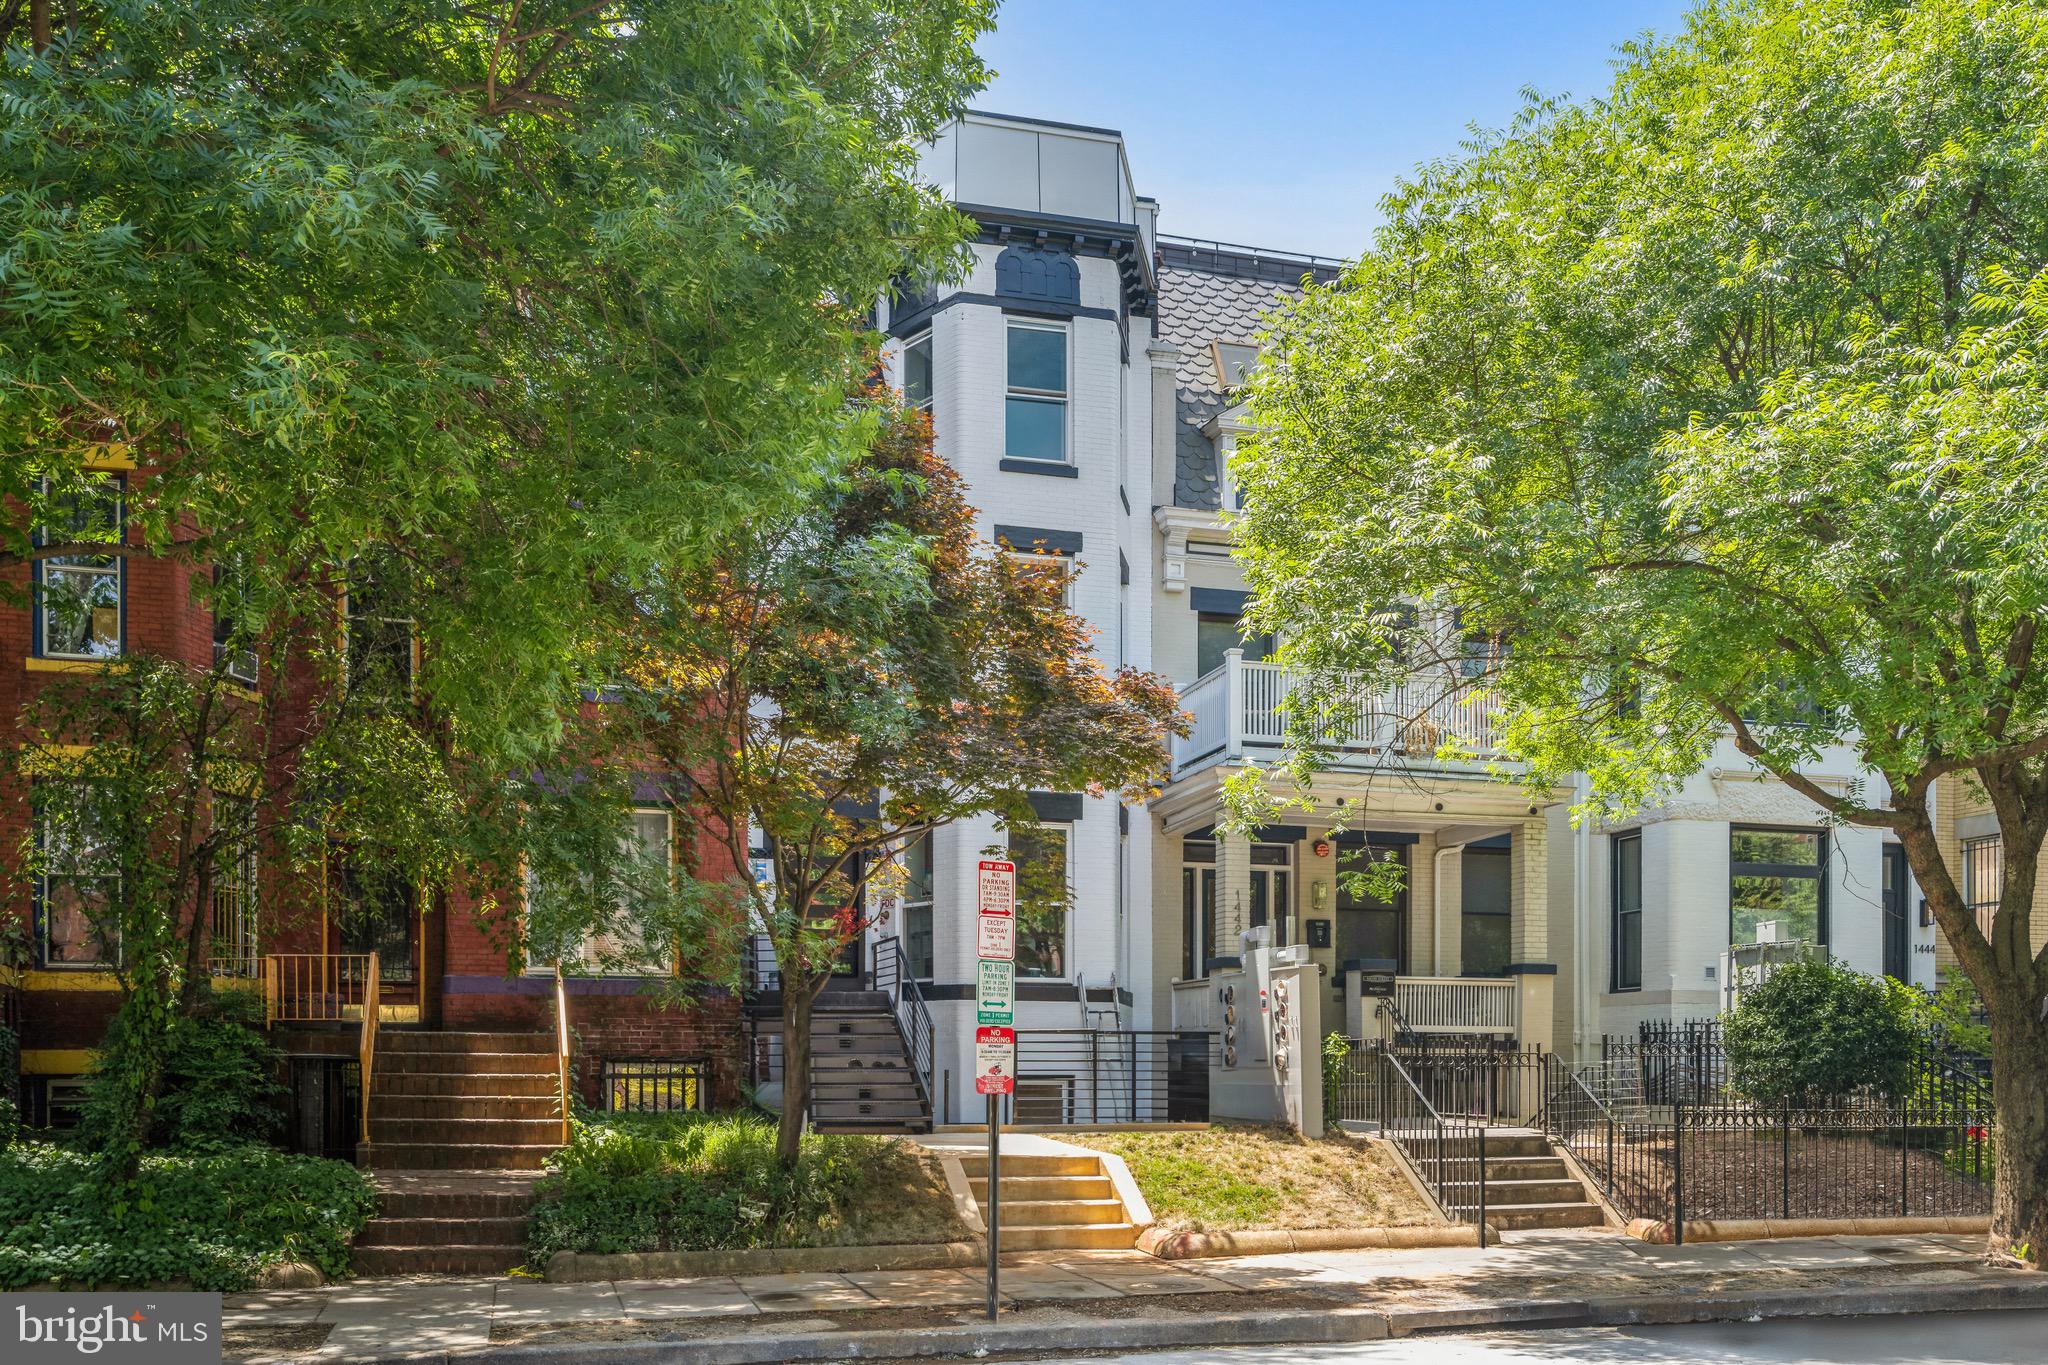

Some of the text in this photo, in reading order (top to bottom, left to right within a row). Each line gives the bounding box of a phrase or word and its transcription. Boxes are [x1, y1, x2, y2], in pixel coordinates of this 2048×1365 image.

[1914, 944, 1936, 954] 1444
[982, 963, 1010, 973] TWO HOUR
[981, 1036, 1010, 1044] PARKING
